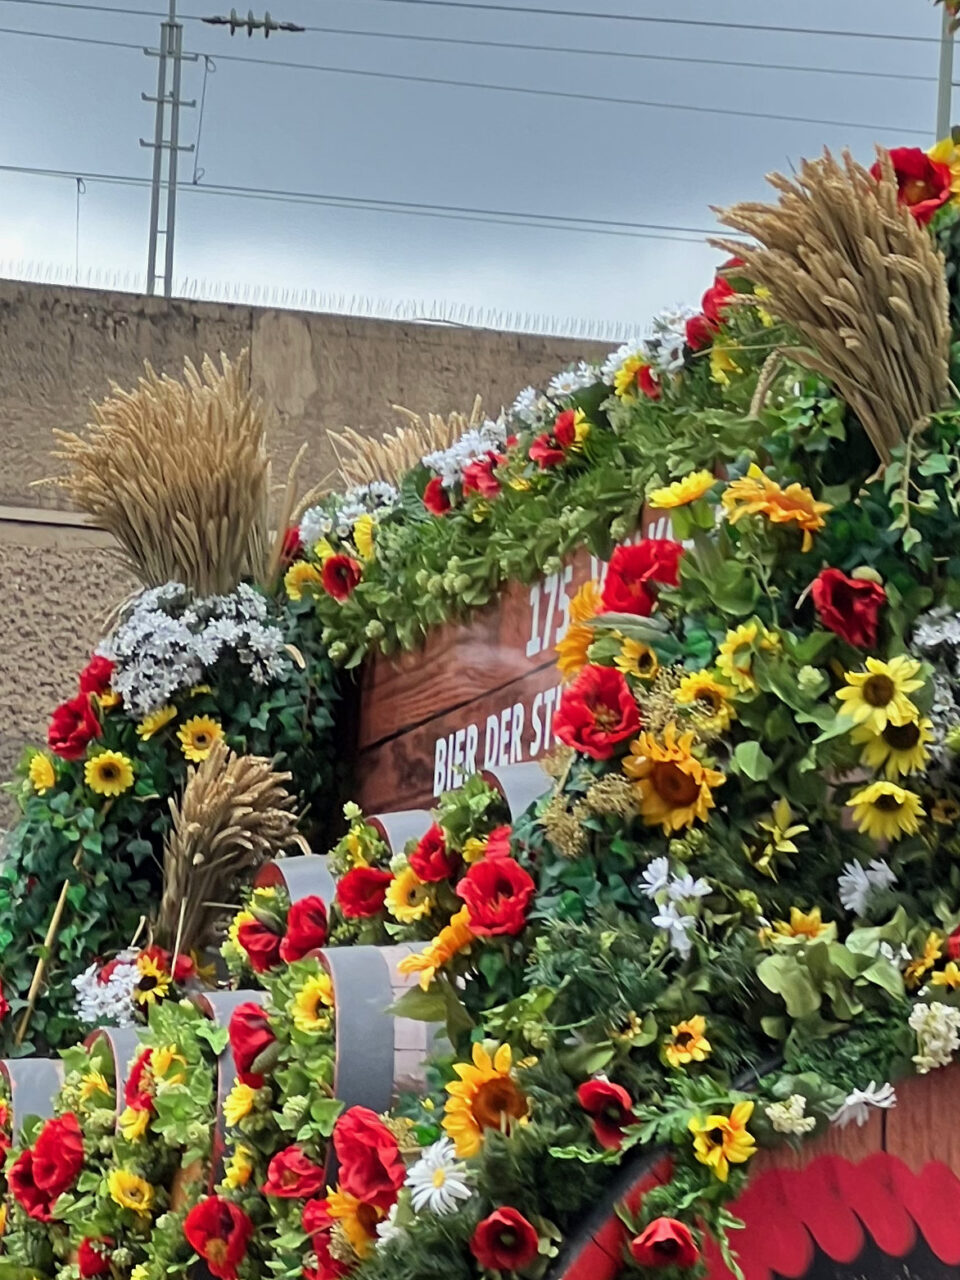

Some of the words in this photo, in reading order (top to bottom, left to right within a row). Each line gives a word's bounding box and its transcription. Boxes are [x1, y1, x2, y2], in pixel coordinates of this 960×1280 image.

[525, 563, 574, 658] 175
[433, 723, 478, 797] BIER
[484, 702, 525, 769] DER
[529, 684, 563, 757] ST
